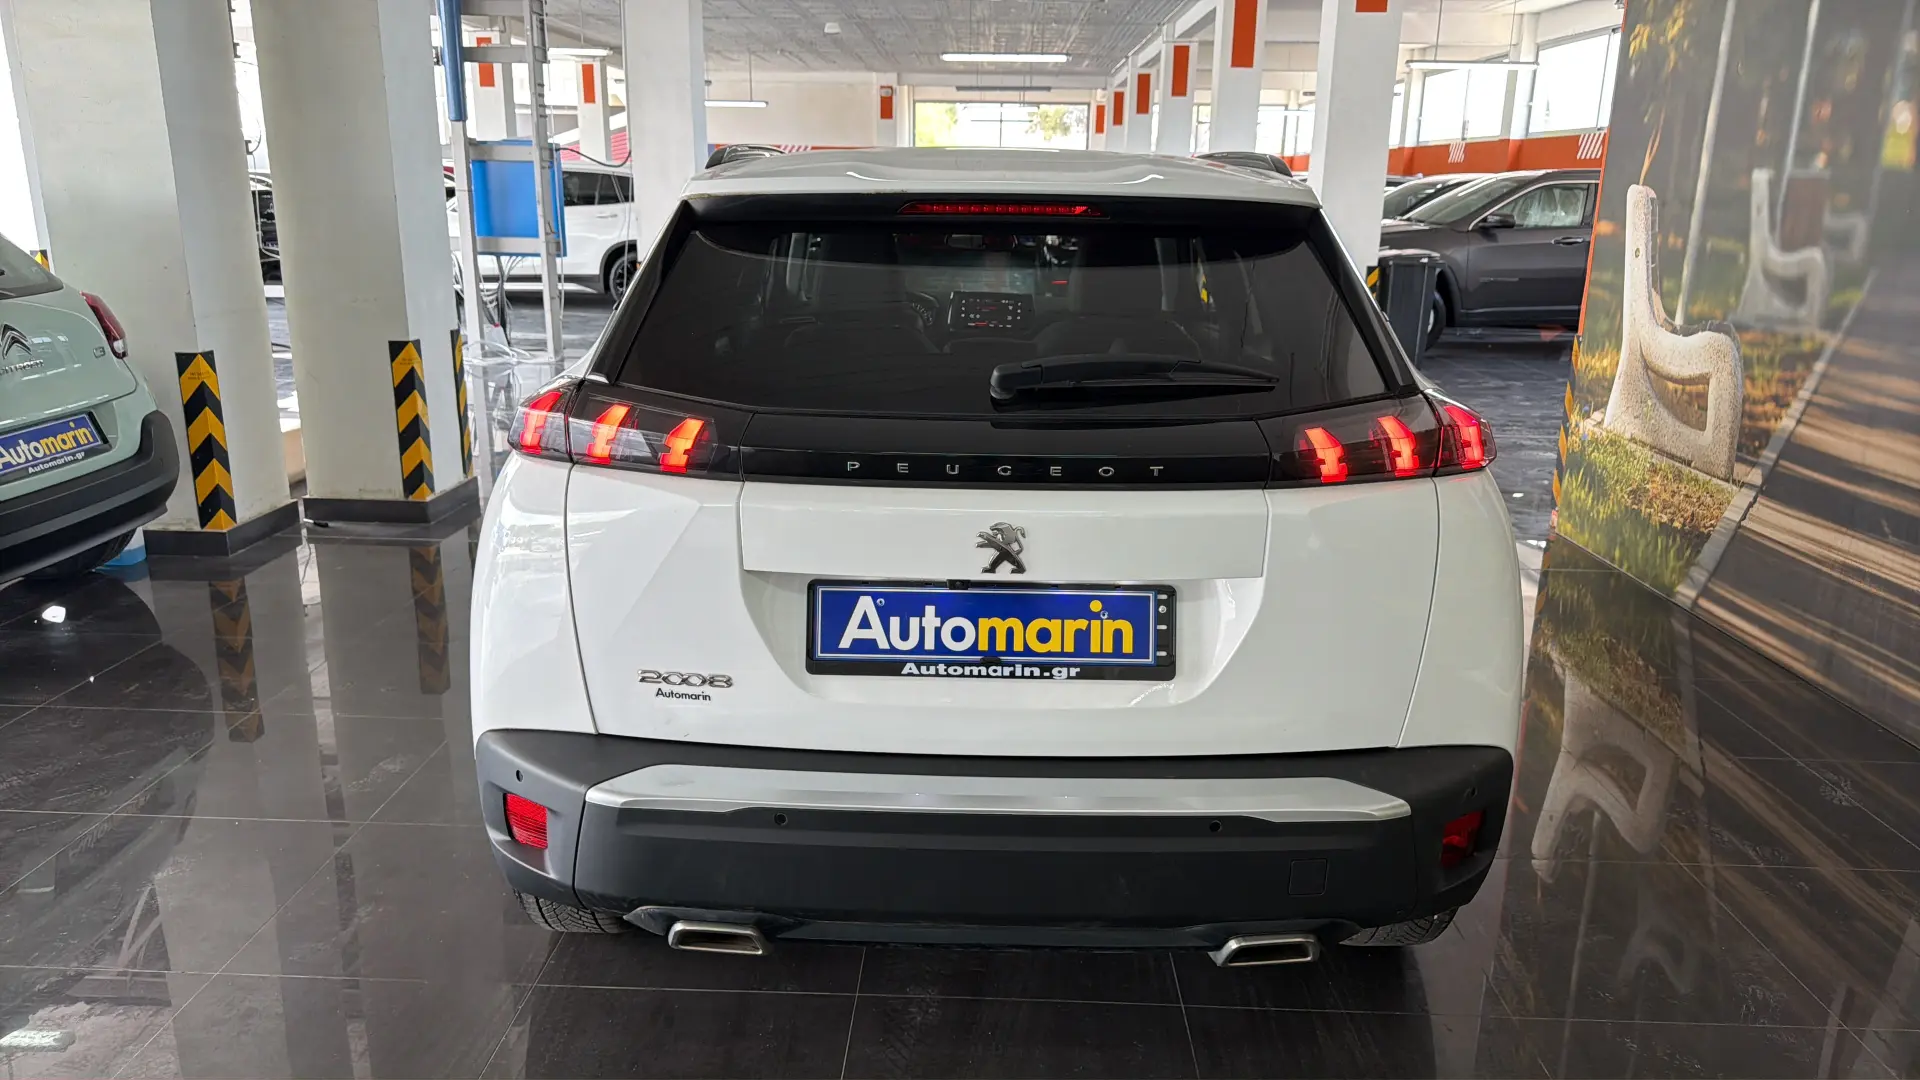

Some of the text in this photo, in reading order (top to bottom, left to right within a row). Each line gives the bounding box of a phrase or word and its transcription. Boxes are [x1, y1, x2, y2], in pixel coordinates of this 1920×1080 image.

[0, 421, 94, 469] Automarin
[28, 451, 86, 474] Automarin.gr
[846, 461, 1164, 477] PEUGEOT
[838, 595, 1134, 654] Automarin
[637, 669, 733, 688] 2008
[900, 661, 1081, 680] Automarin.gr
[655, 687, 712, 702] Automarin
